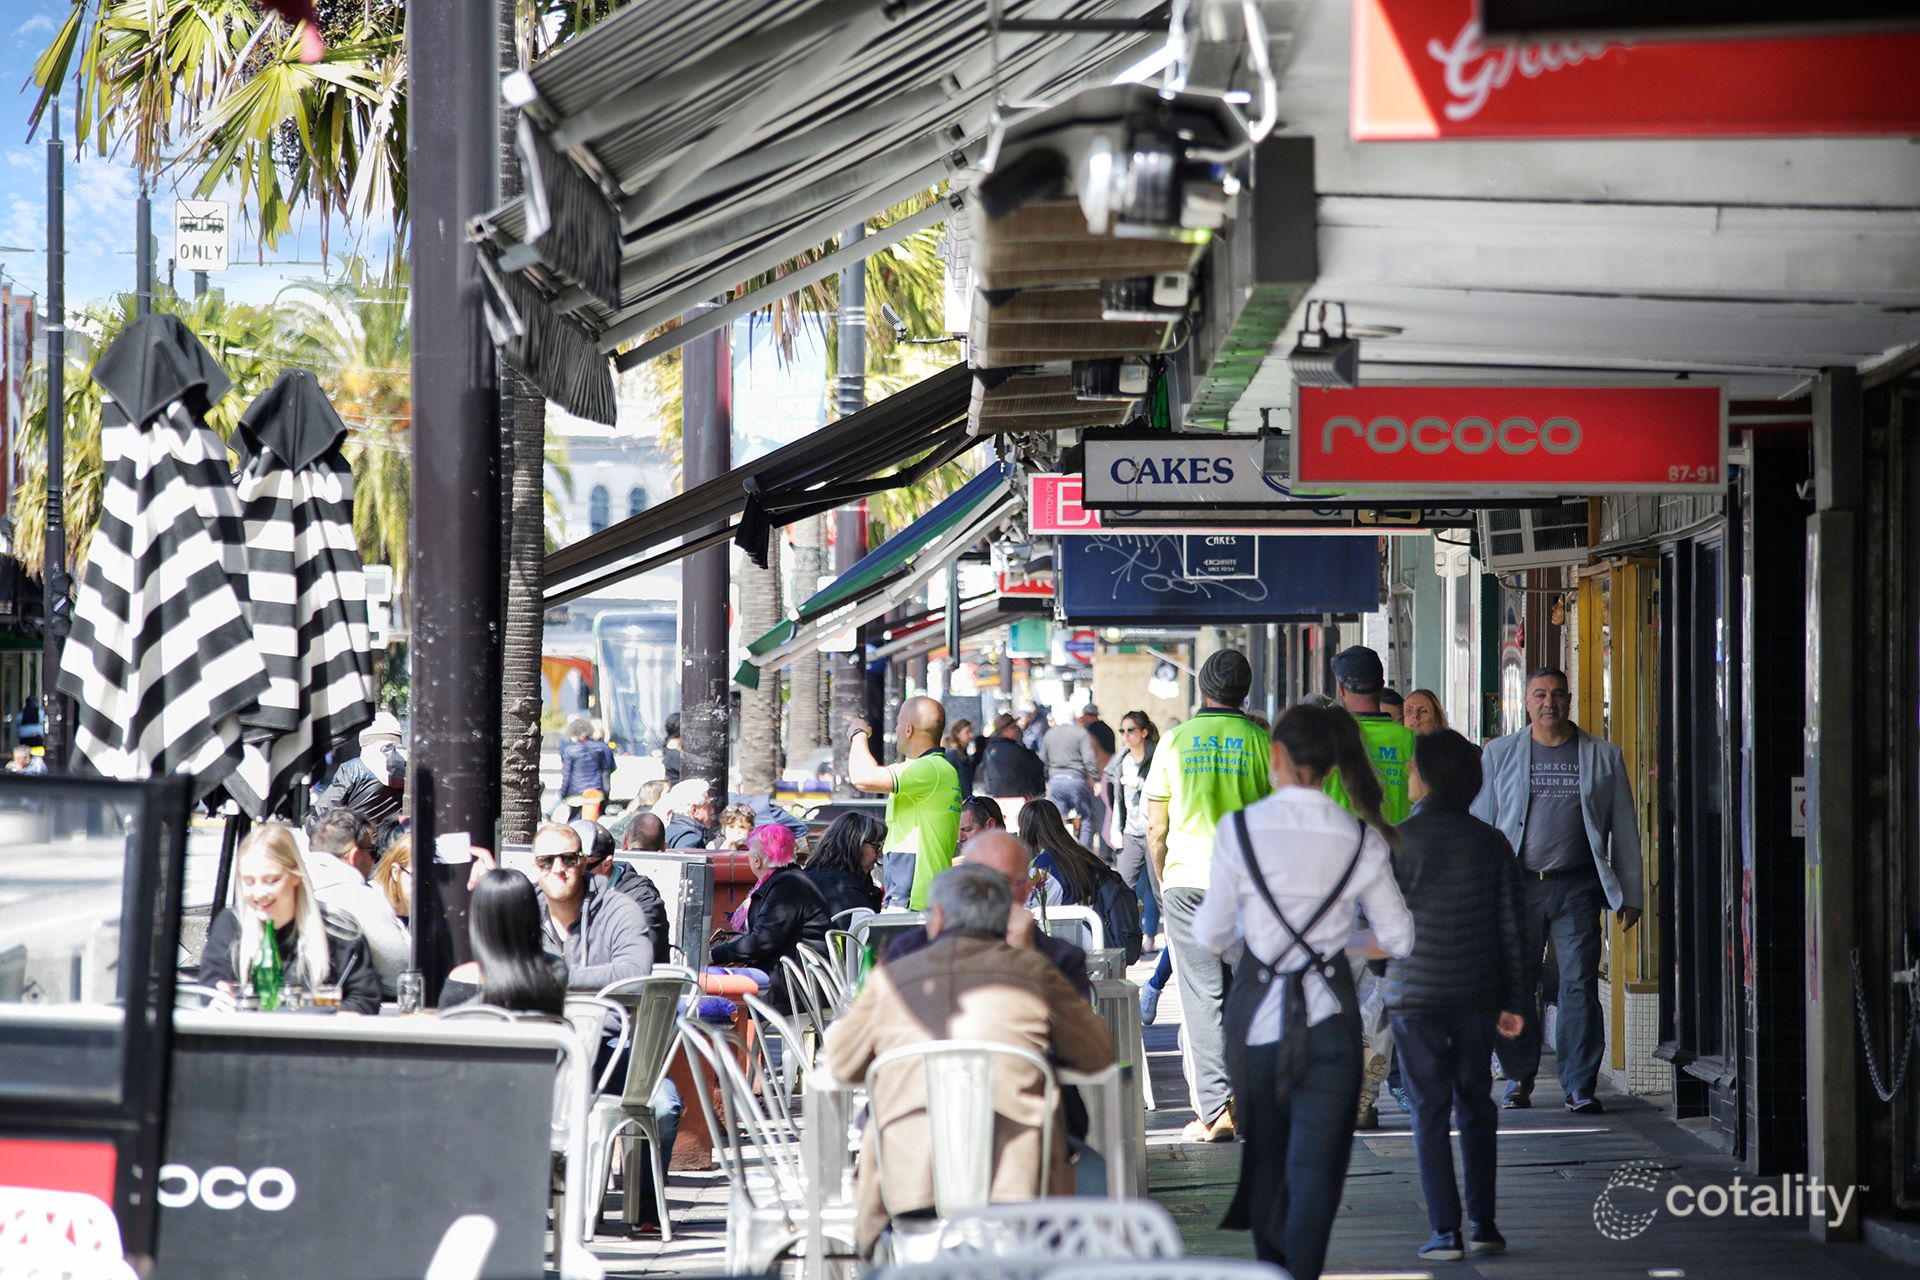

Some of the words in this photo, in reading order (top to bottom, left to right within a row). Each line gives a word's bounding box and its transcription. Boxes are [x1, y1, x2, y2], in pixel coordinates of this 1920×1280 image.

[180, 244, 223, 260] ONLY
[1321, 416, 1582, 455] rococo
[1110, 457, 1234, 485] CAKES
[1668, 465, 1716, 482] 87-91
[1205, 536, 1236, 546] CAKES
[1192, 736, 1244, 749] I.S.M
